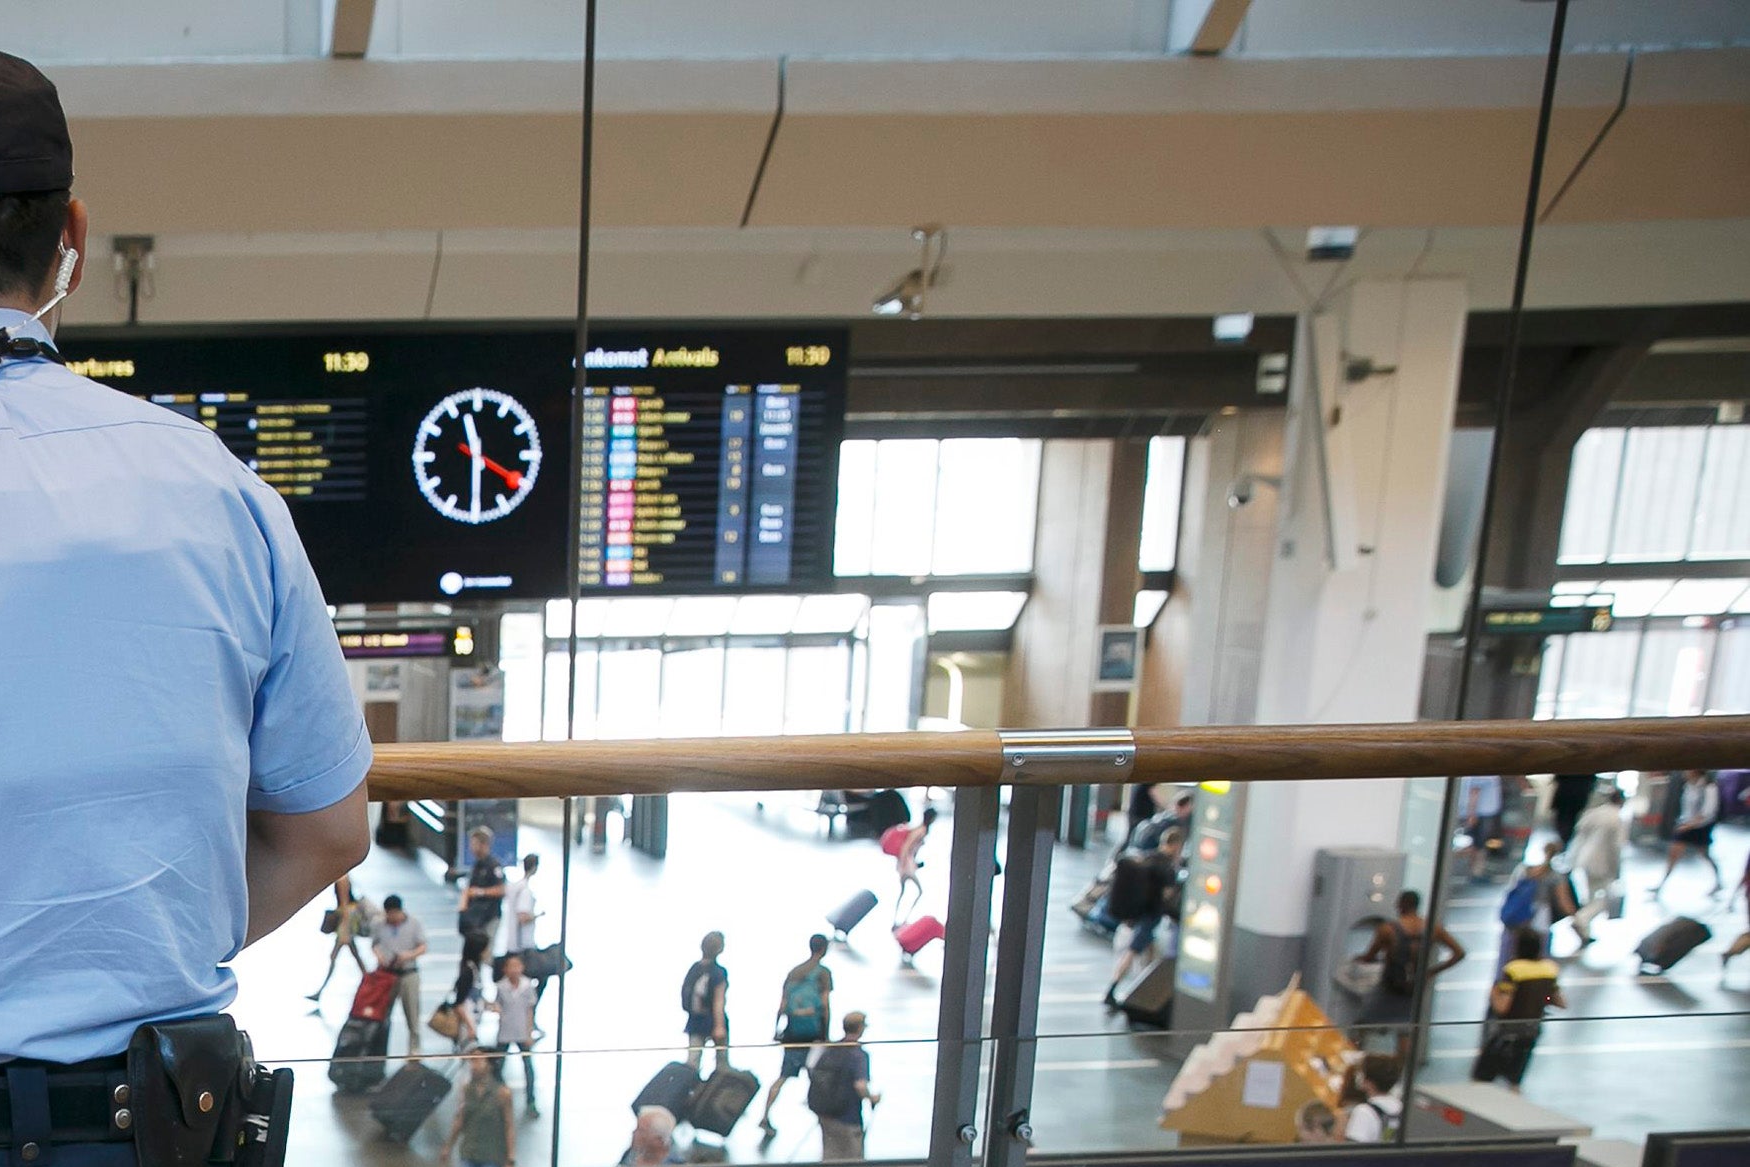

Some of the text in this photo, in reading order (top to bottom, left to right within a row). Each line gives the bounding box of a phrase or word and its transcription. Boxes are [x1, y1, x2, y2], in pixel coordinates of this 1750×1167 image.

[65, 357, 135, 377] artures
[324, 351, 369, 372] 11:30
[573, 348, 648, 368] nkomst
